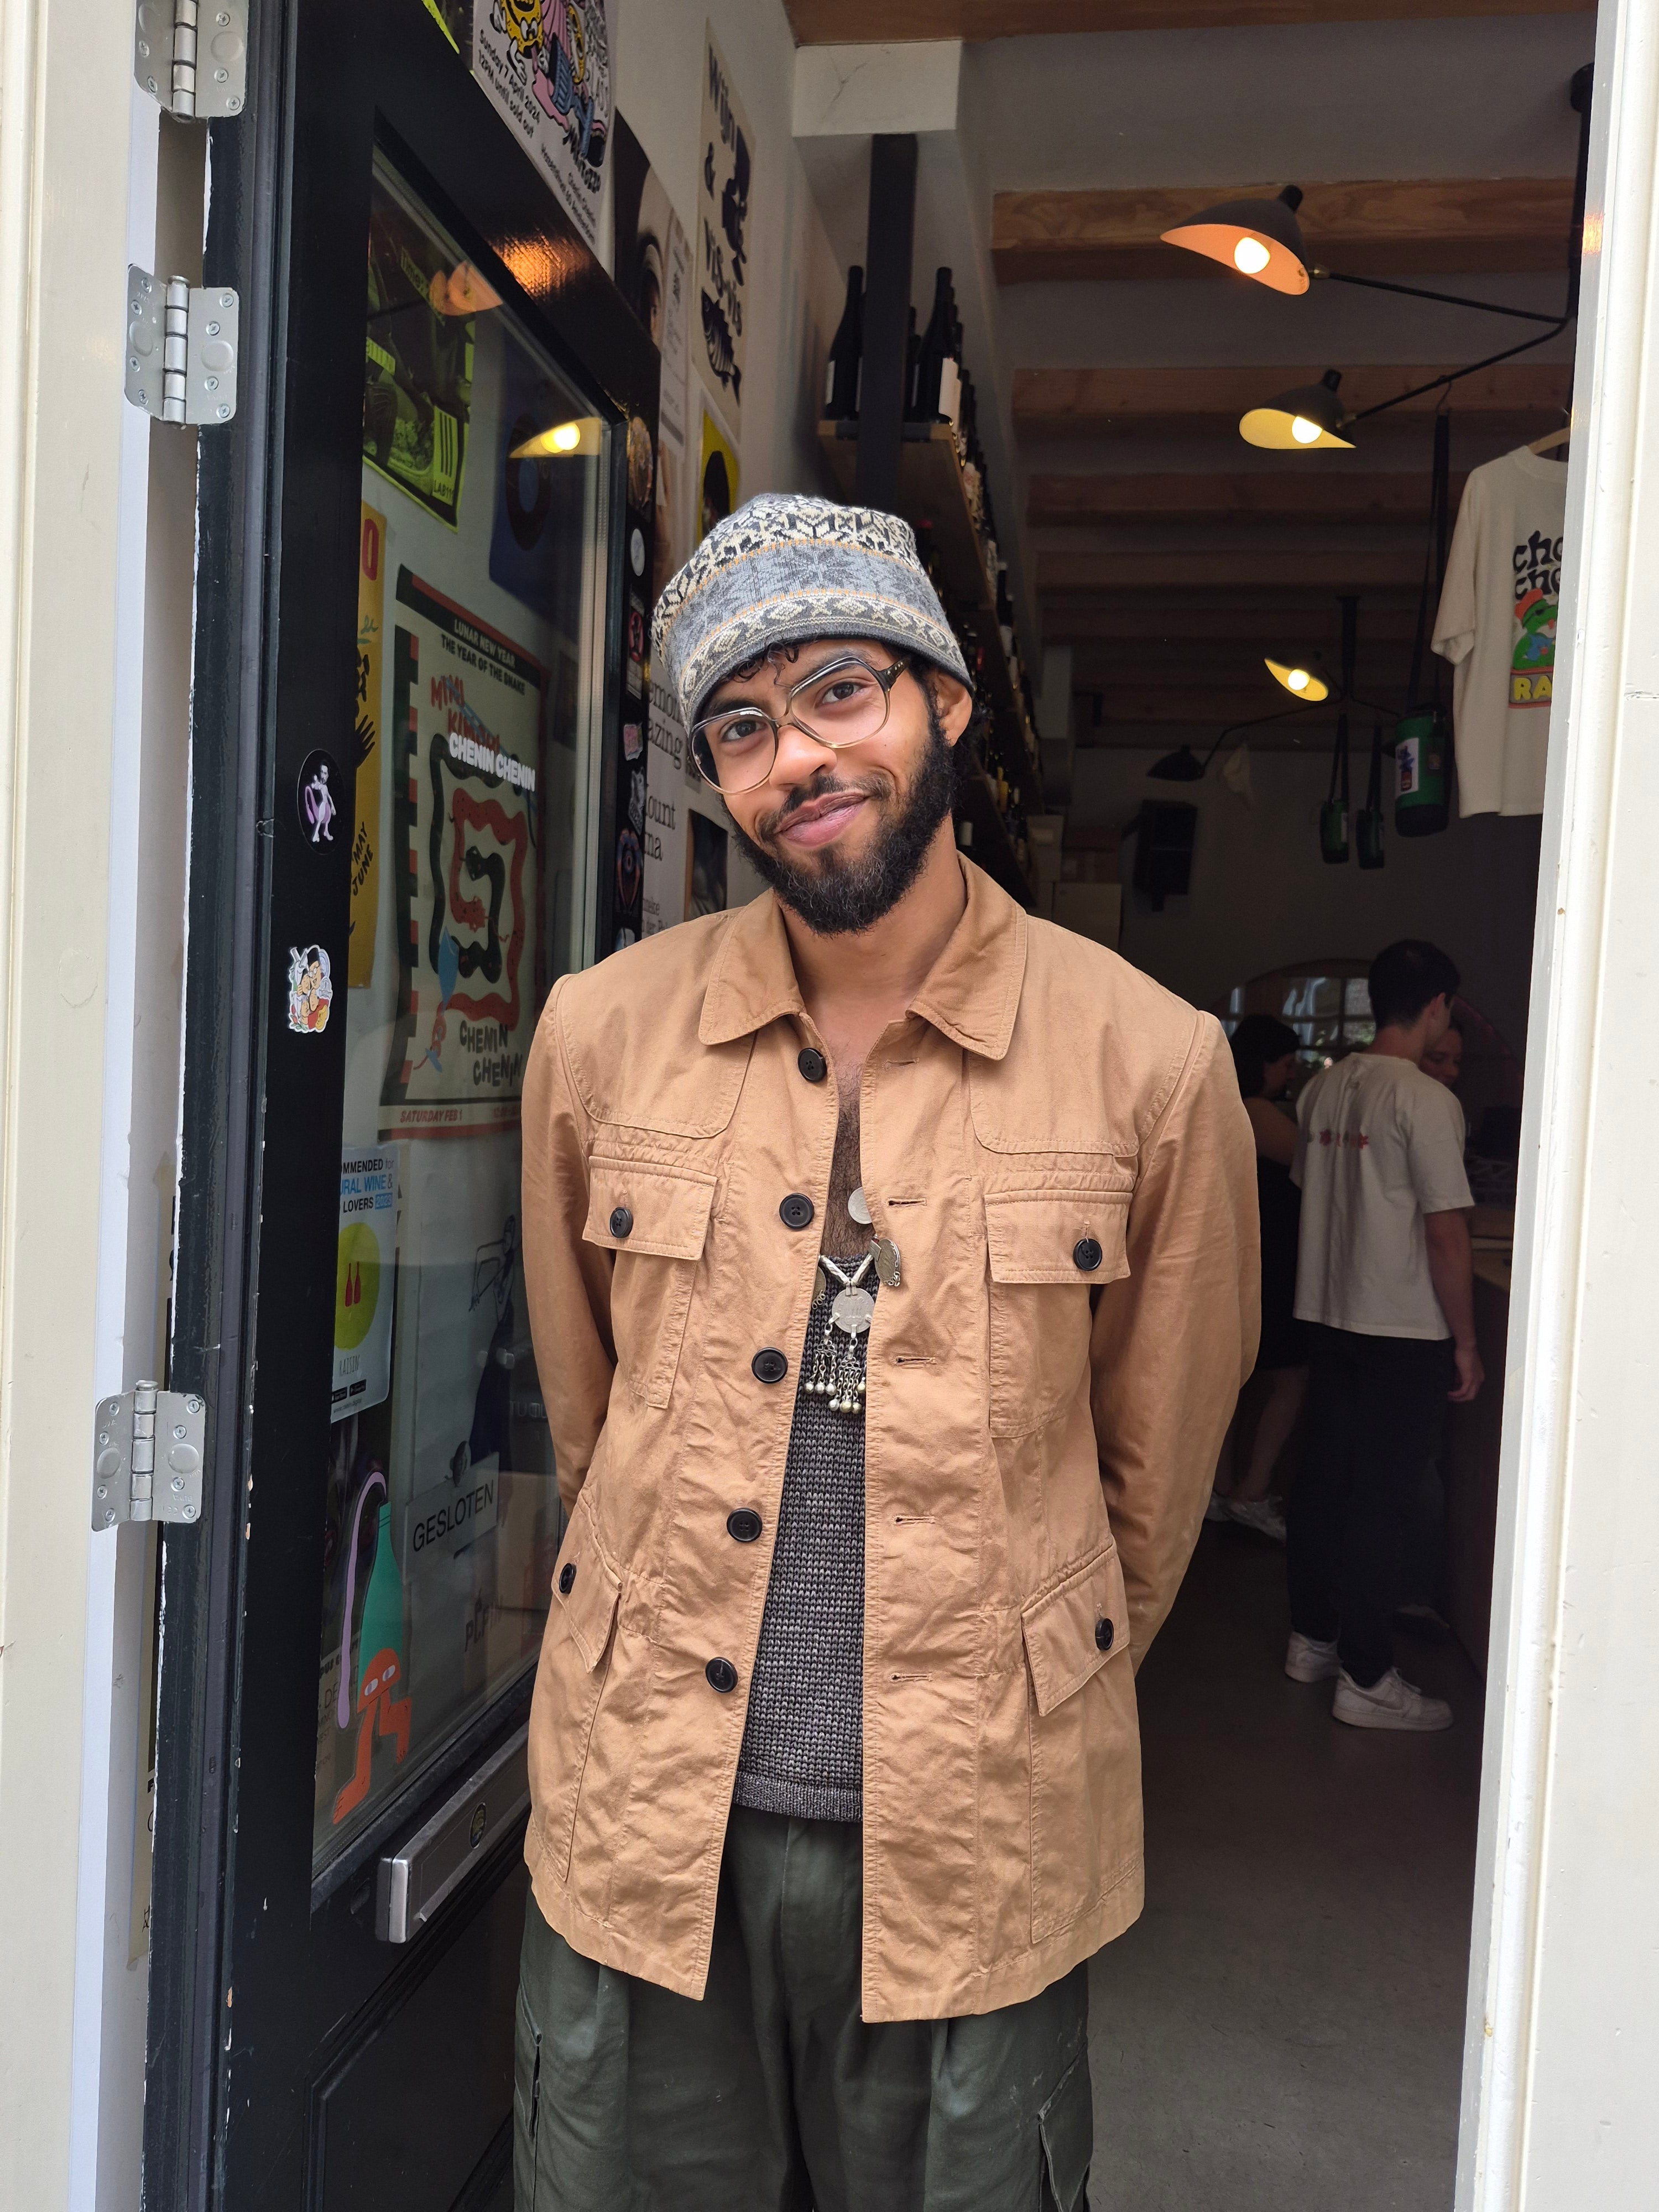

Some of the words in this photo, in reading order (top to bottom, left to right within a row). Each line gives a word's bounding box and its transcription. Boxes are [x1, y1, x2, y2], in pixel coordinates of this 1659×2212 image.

[480, 29, 503, 74] Sunday
[509, 74, 524, 102] April
[525, 95, 540, 125] 2024
[441, 634, 455, 655] THE
[457, 644, 477, 667] YEAR
[478, 656, 488, 673] OF
[489, 664, 503, 682] THE
[454, 619, 479, 648] LUNAR
[480, 637, 495, 656] NEW
[497, 645, 515, 669] YEAR
[449, 732, 494, 774] CHENIN
[495, 753, 535, 792] CHENIN
[352, 844, 373, 896] JUNE
[460, 1020, 508, 1053] CHENIN
[473, 1052, 523, 1087] CHENIN
[400, 1110, 444, 1123] SATURDAY
[445, 1109, 458, 1121] FEB
[341, 1159, 383, 1174] MMENDED
[385, 1158, 394, 1170] for
[364, 1174, 386, 1192] WINE
[388, 1173, 393, 1189] &
[343, 1197, 373, 1213] LOVERS
[413, 1479, 494, 1552] GESLOTEN
